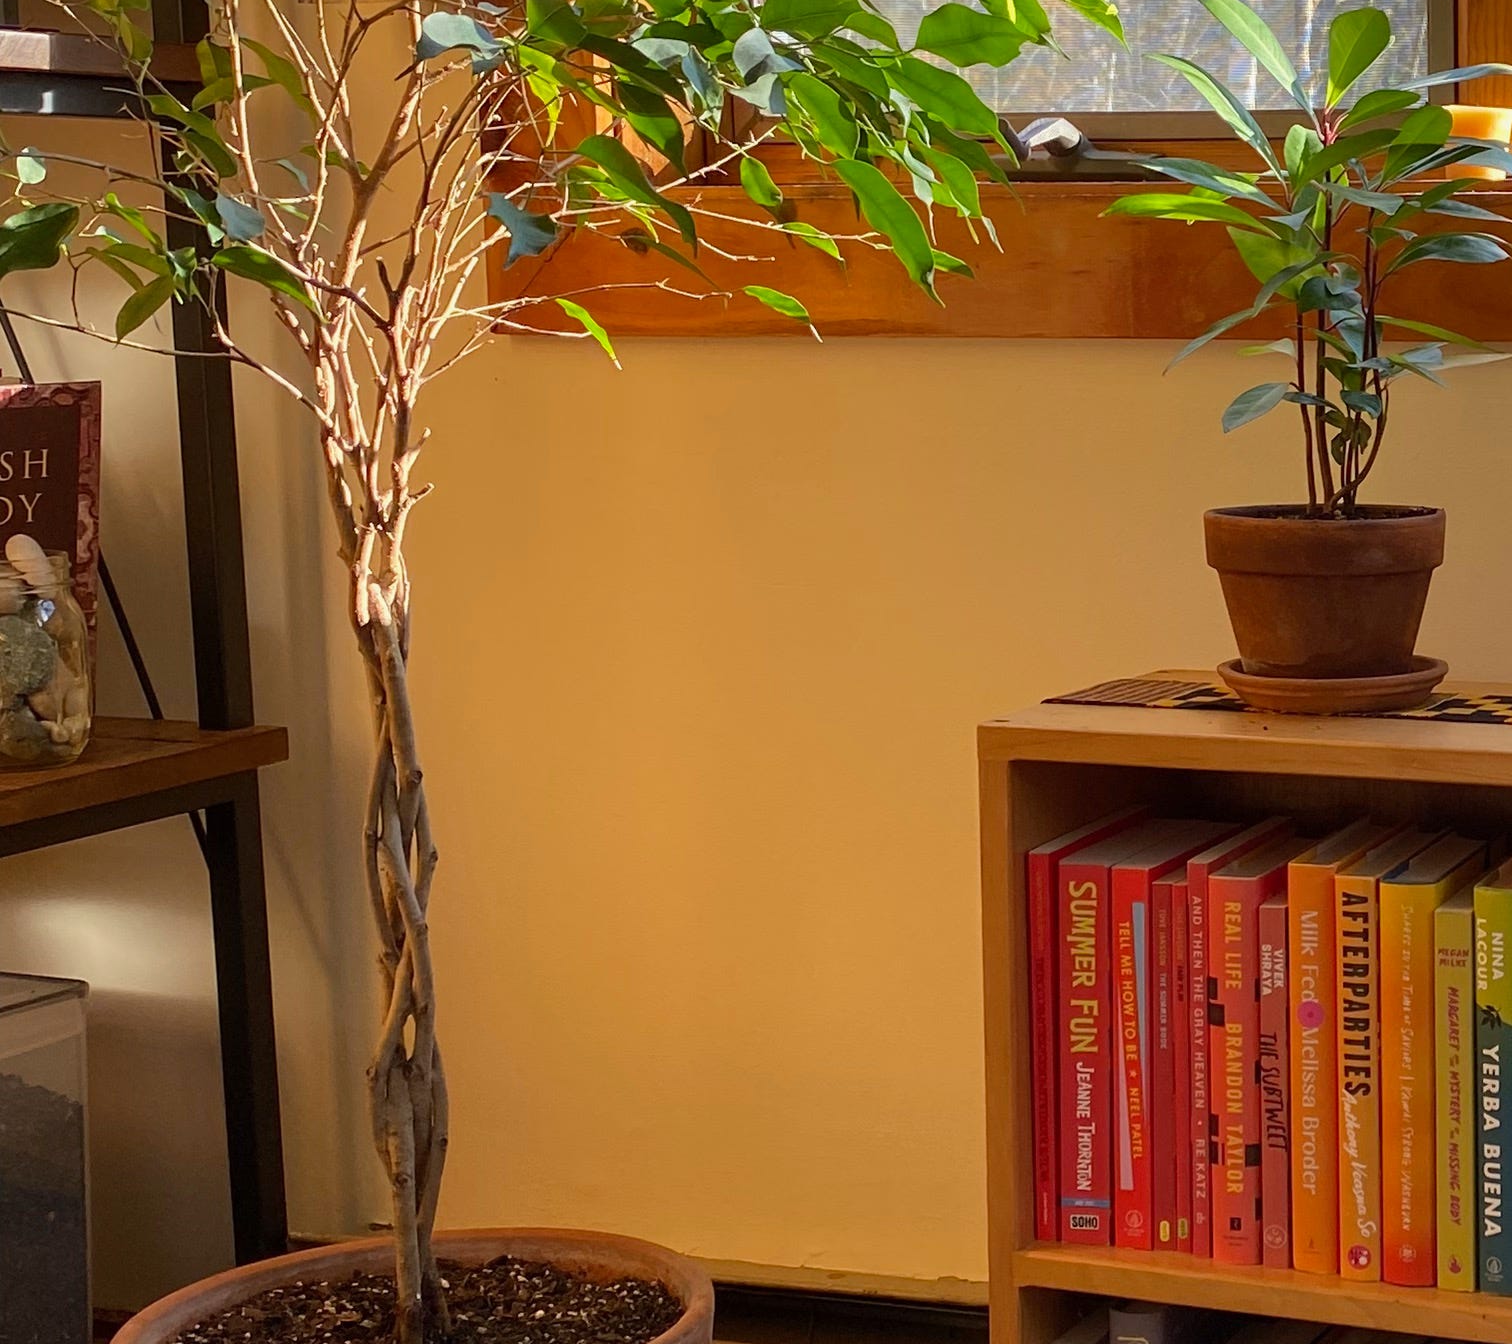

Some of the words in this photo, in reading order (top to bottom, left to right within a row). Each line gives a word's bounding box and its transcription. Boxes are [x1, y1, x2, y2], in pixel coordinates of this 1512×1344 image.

[1067, 880, 1098, 988] SUMMER
[1224, 901, 1242, 944] REAL
[1300, 910, 1319, 956] Milk
[1225, 952, 1242, 990] LIFE
[1261, 943, 1273, 996] SHRAYA
[1273, 949, 1286, 988] VIVEK
[1437, 947, 1469, 958] MEGAN
[1438, 958, 1467, 968] MILKS
[1476, 917, 1488, 991] LACOUR
[1491, 932, 1505, 980] NINA
[1301, 965, 1320, 1004] Fed
[1341, 891, 1371, 1098] AFTERPARTIES
[1069, 999, 1099, 1053] FUN
[1076, 1062, 1095, 1119] JEANNE
[1226, 1022, 1243, 1113] BRANDON
[1301, 1027, 1319, 1108] Melissa
[1481, 1044, 1500, 1132] YERBA
[1076, 1122, 1096, 1191] THORNTON
[1226, 1124, 1244, 1193] TAYLOR
[1302, 1116, 1320, 1196] Broder
[1483, 1144, 1502, 1237] BUENA
[1072, 1215, 1098, 1229] SOHO
